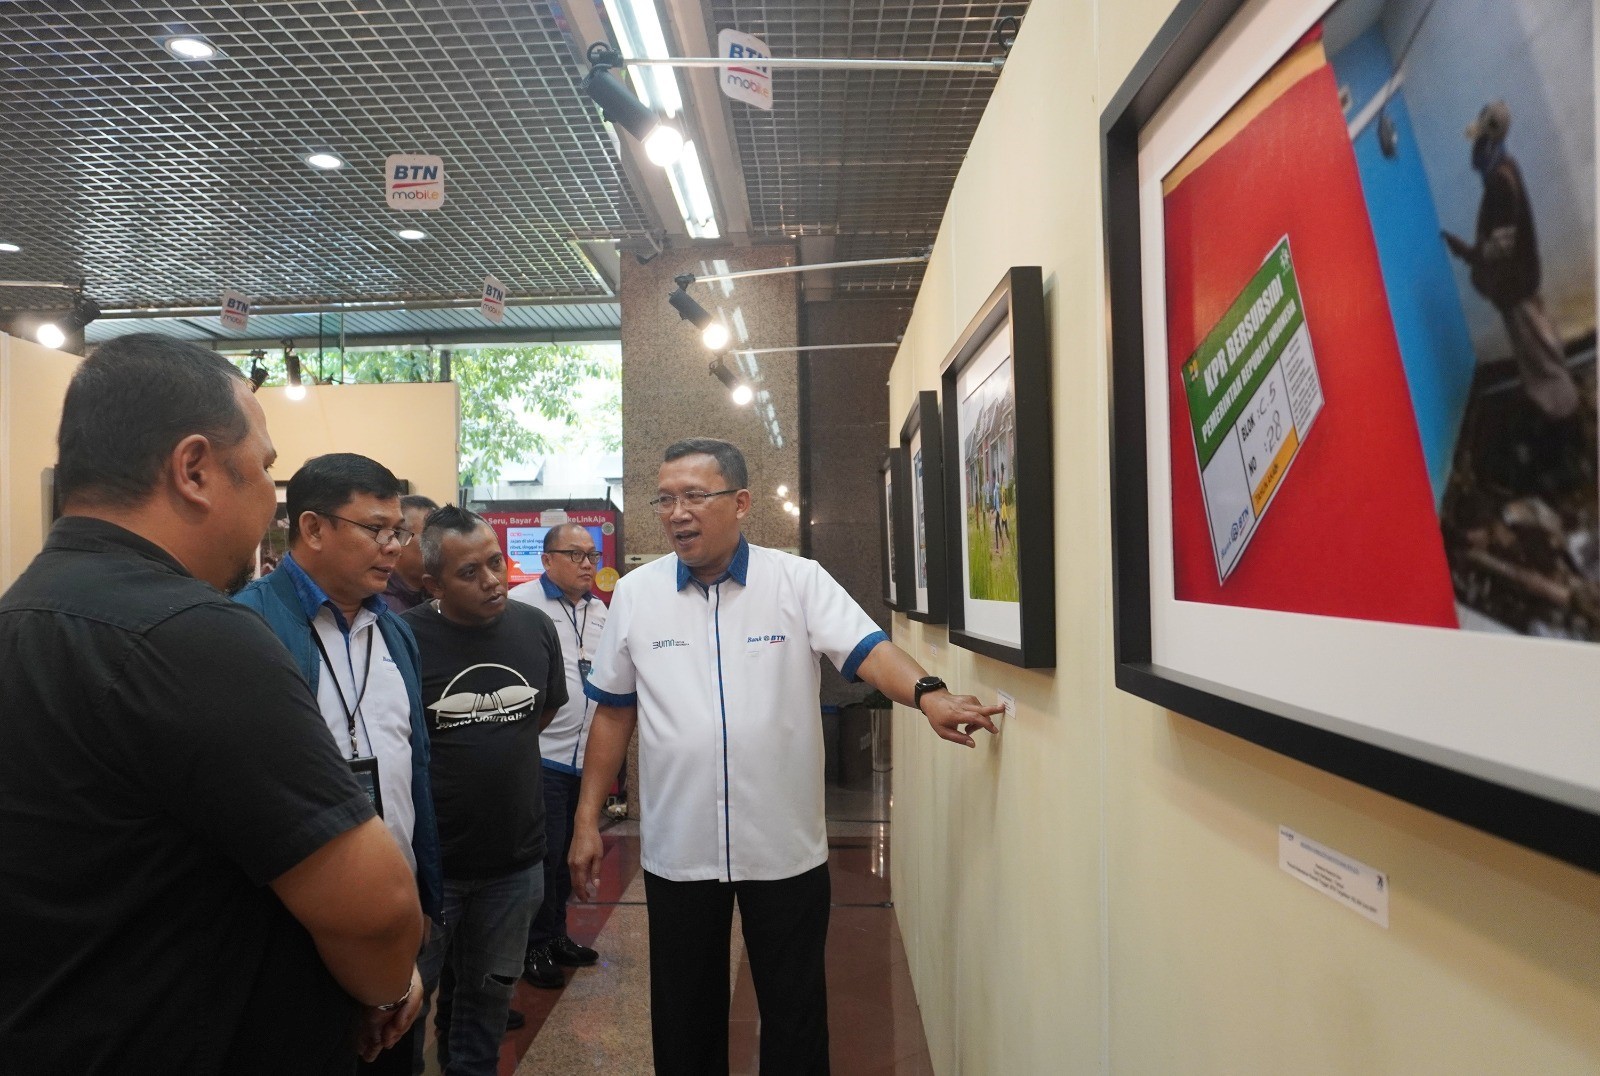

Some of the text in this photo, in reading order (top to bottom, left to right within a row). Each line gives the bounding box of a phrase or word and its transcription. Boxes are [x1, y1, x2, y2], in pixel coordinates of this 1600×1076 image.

[393, 165, 438, 180] BTN
[392, 190, 439, 199] mobile
[486, 284, 503, 301] BTN
[227, 298, 249, 313] BTN
[1204, 273, 1284, 397] KPR BERSUBSIDI
[1202, 374, 1243, 443] PEMERINTAH
[1240, 335, 1270, 387] REPUBLIK
[1241, 413, 1255, 442] BLOK
[510, 517, 531, 525] Bayar
[567, 515, 606, 524] keLinkAja
